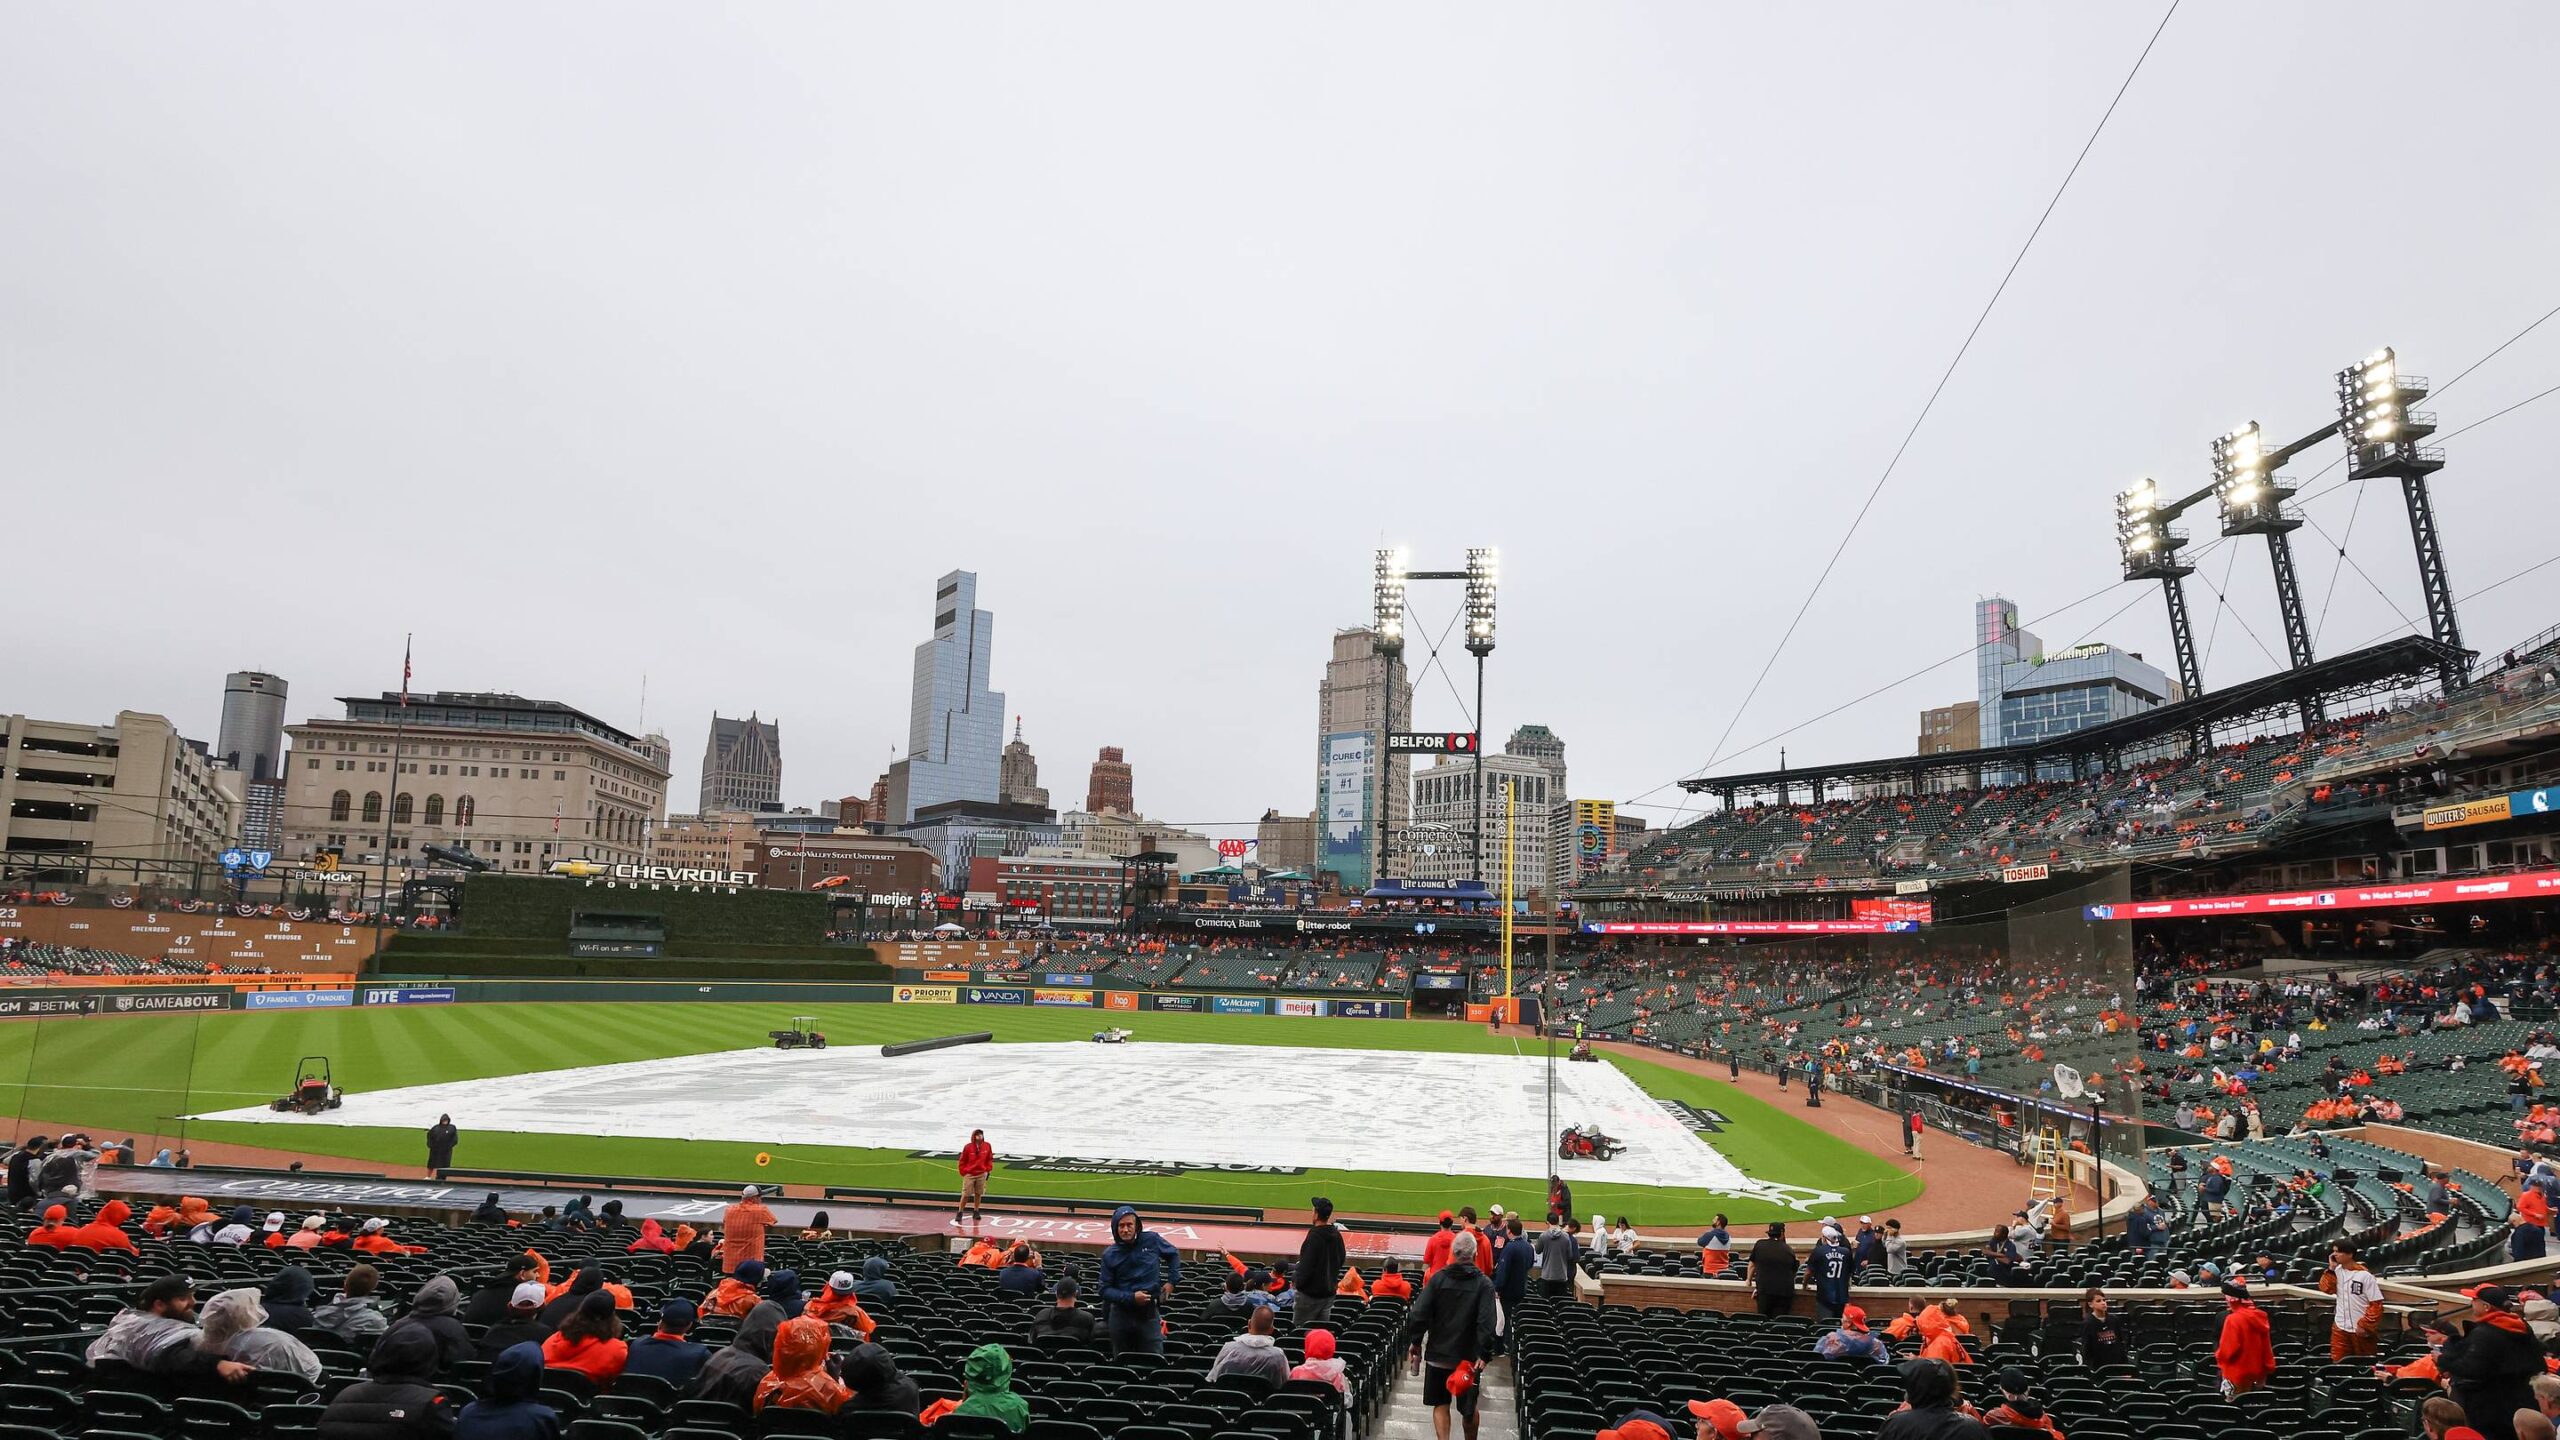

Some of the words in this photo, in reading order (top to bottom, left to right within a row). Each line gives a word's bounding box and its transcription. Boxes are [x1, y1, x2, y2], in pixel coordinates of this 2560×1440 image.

[2042, 644, 2108, 663] Huntington
[1389, 736, 1445, 748] BELFOR
[1332, 752, 1355, 761] CURE
[1340, 777, 1352, 789] #1
[2426, 807, 2467, 826] WINTER'S
[2467, 803, 2507, 817] SAUSAGE
[1220, 840, 1246, 856] AAA
[780, 850, 806, 858] GRAND
[806, 851, 831, 859] VALLEY
[831, 851, 853, 859] STATE
[853, 852, 896, 861] UNIVERSITY
[295, 871, 352, 882] BETMGM
[615, 863, 759, 885] CHEVROLET
[2005, 865, 2046, 881] TOSHIBA
[585, 879, 737, 895] FOUNTAIN
[1400, 879, 1416, 890] Lite
[1250, 884, 1266, 897] Lite
[871, 891, 914, 908] meijer
[1020, 906, 1038, 915] LAW
[148, 914, 157, 924] 5
[216, 918, 224, 928] 2
[1239, 919, 1262, 928] Bank
[279, 922, 291, 932] 16
[343, 927, 350, 937] 6
[175, 935, 191, 946] 47
[244, 940, 253, 950] 3
[315, 943, 321, 953] 1
[980, 943, 987, 951] 10
[317, 994, 346, 1002] FANDUEL
[368, 990, 399, 1004] DTE
[914, 989, 952, 997] PRIORITY
[982, 992, 1021, 1000] VANDA
[135, 995, 219, 1010] GAMEABOVE
[1158, 996, 1180, 1004] ESPN
[1180, 997, 1198, 1005] BET
[1229, 999, 1260, 1007] McLaren
[1286, 1001, 1313, 1014] meije
[1345, 1006, 1370, 1016] Corona
[1028, 1163, 1158, 1177] Booking.com
[1825, 1251, 1846, 1261] GREENE
[1826, 1261, 1843, 1279] 31
